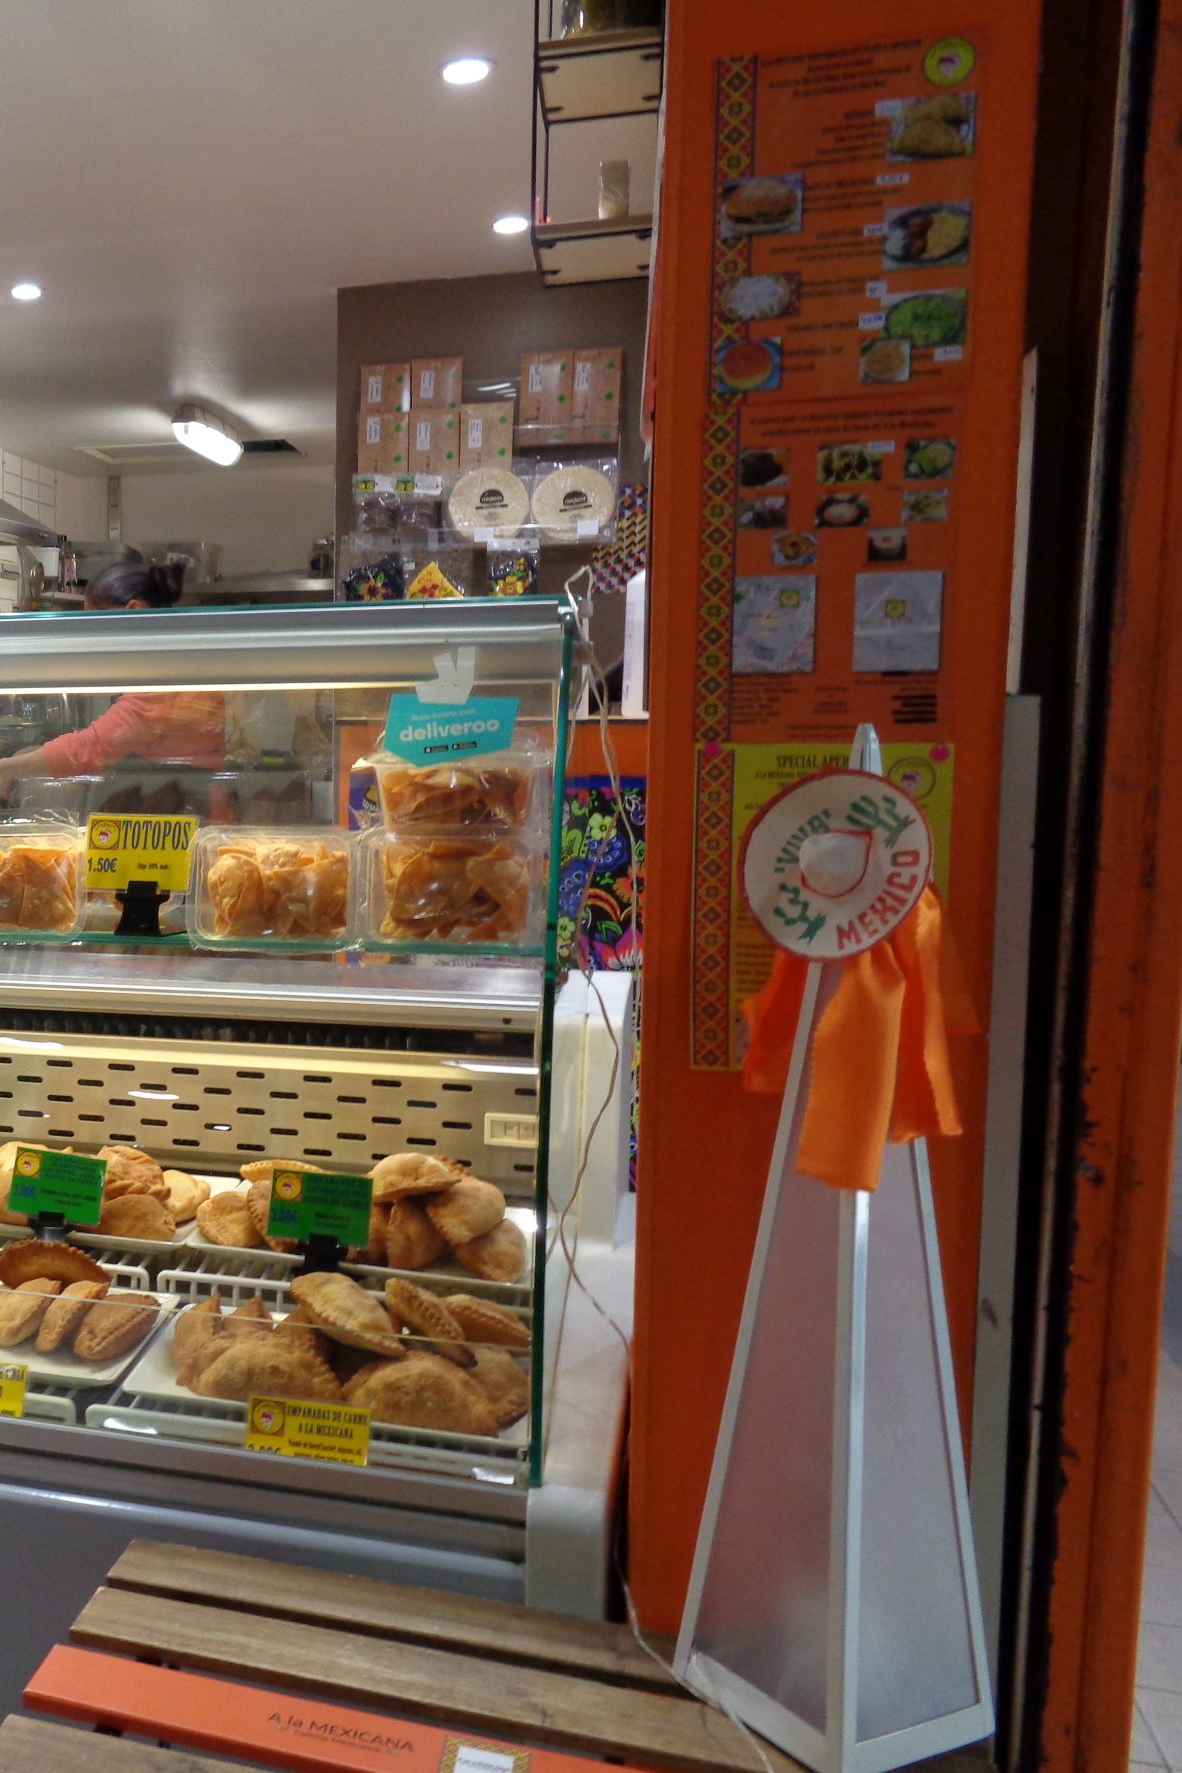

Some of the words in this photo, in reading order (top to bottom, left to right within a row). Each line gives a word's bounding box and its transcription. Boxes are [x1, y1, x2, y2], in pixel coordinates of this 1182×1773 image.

[400, 719, 501, 742] deliveroo
[822, 754, 850, 768] APER
[121, 820, 192, 851] TOTOPOS
[87, 857, 118, 873] 1.50€
[835, 849, 920, 951] MEXICO
[287, 1404, 331, 1418] EMPANADAS
[268, 1712, 282, 1723] A
[308, 1720, 415, 1752] MEXICANA
